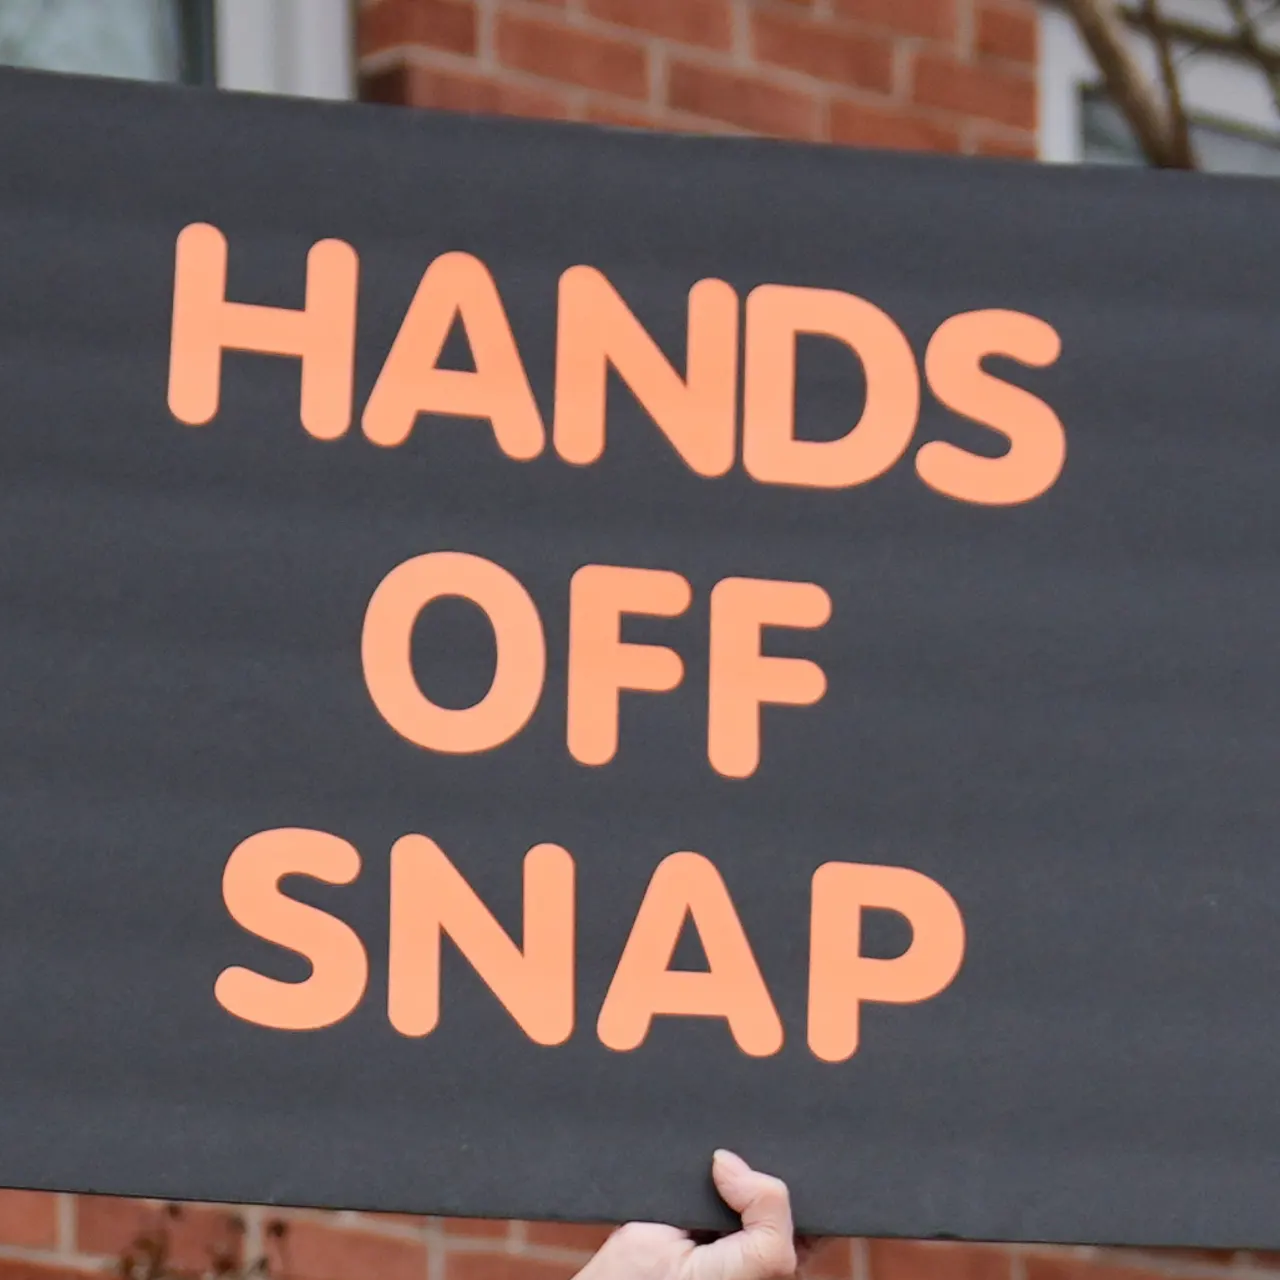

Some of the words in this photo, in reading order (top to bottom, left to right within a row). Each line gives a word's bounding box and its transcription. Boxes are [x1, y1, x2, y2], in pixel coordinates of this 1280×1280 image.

[168, 223, 1066, 507] HANDS
[363, 553, 833, 780] OFF
[214, 829, 967, 1064] SNAP
